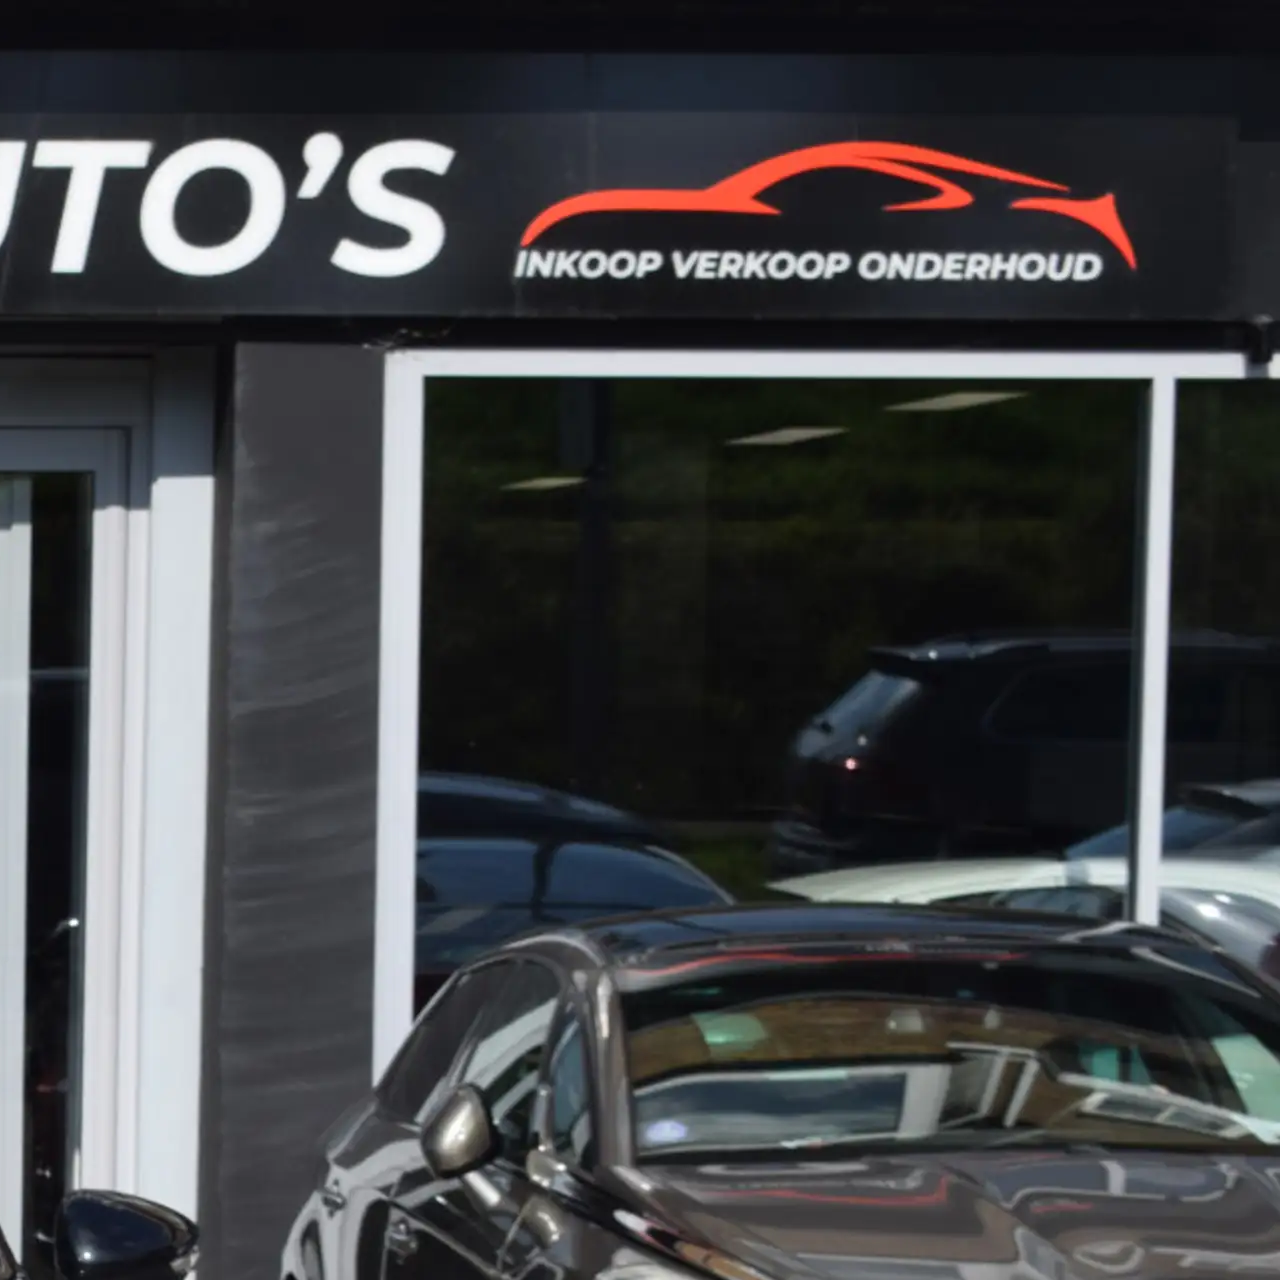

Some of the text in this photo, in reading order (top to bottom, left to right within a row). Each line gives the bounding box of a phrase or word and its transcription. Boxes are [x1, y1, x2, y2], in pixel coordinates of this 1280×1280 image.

[514, 249, 1103, 282] INKOOP VERKOOP ONDERHOUD
